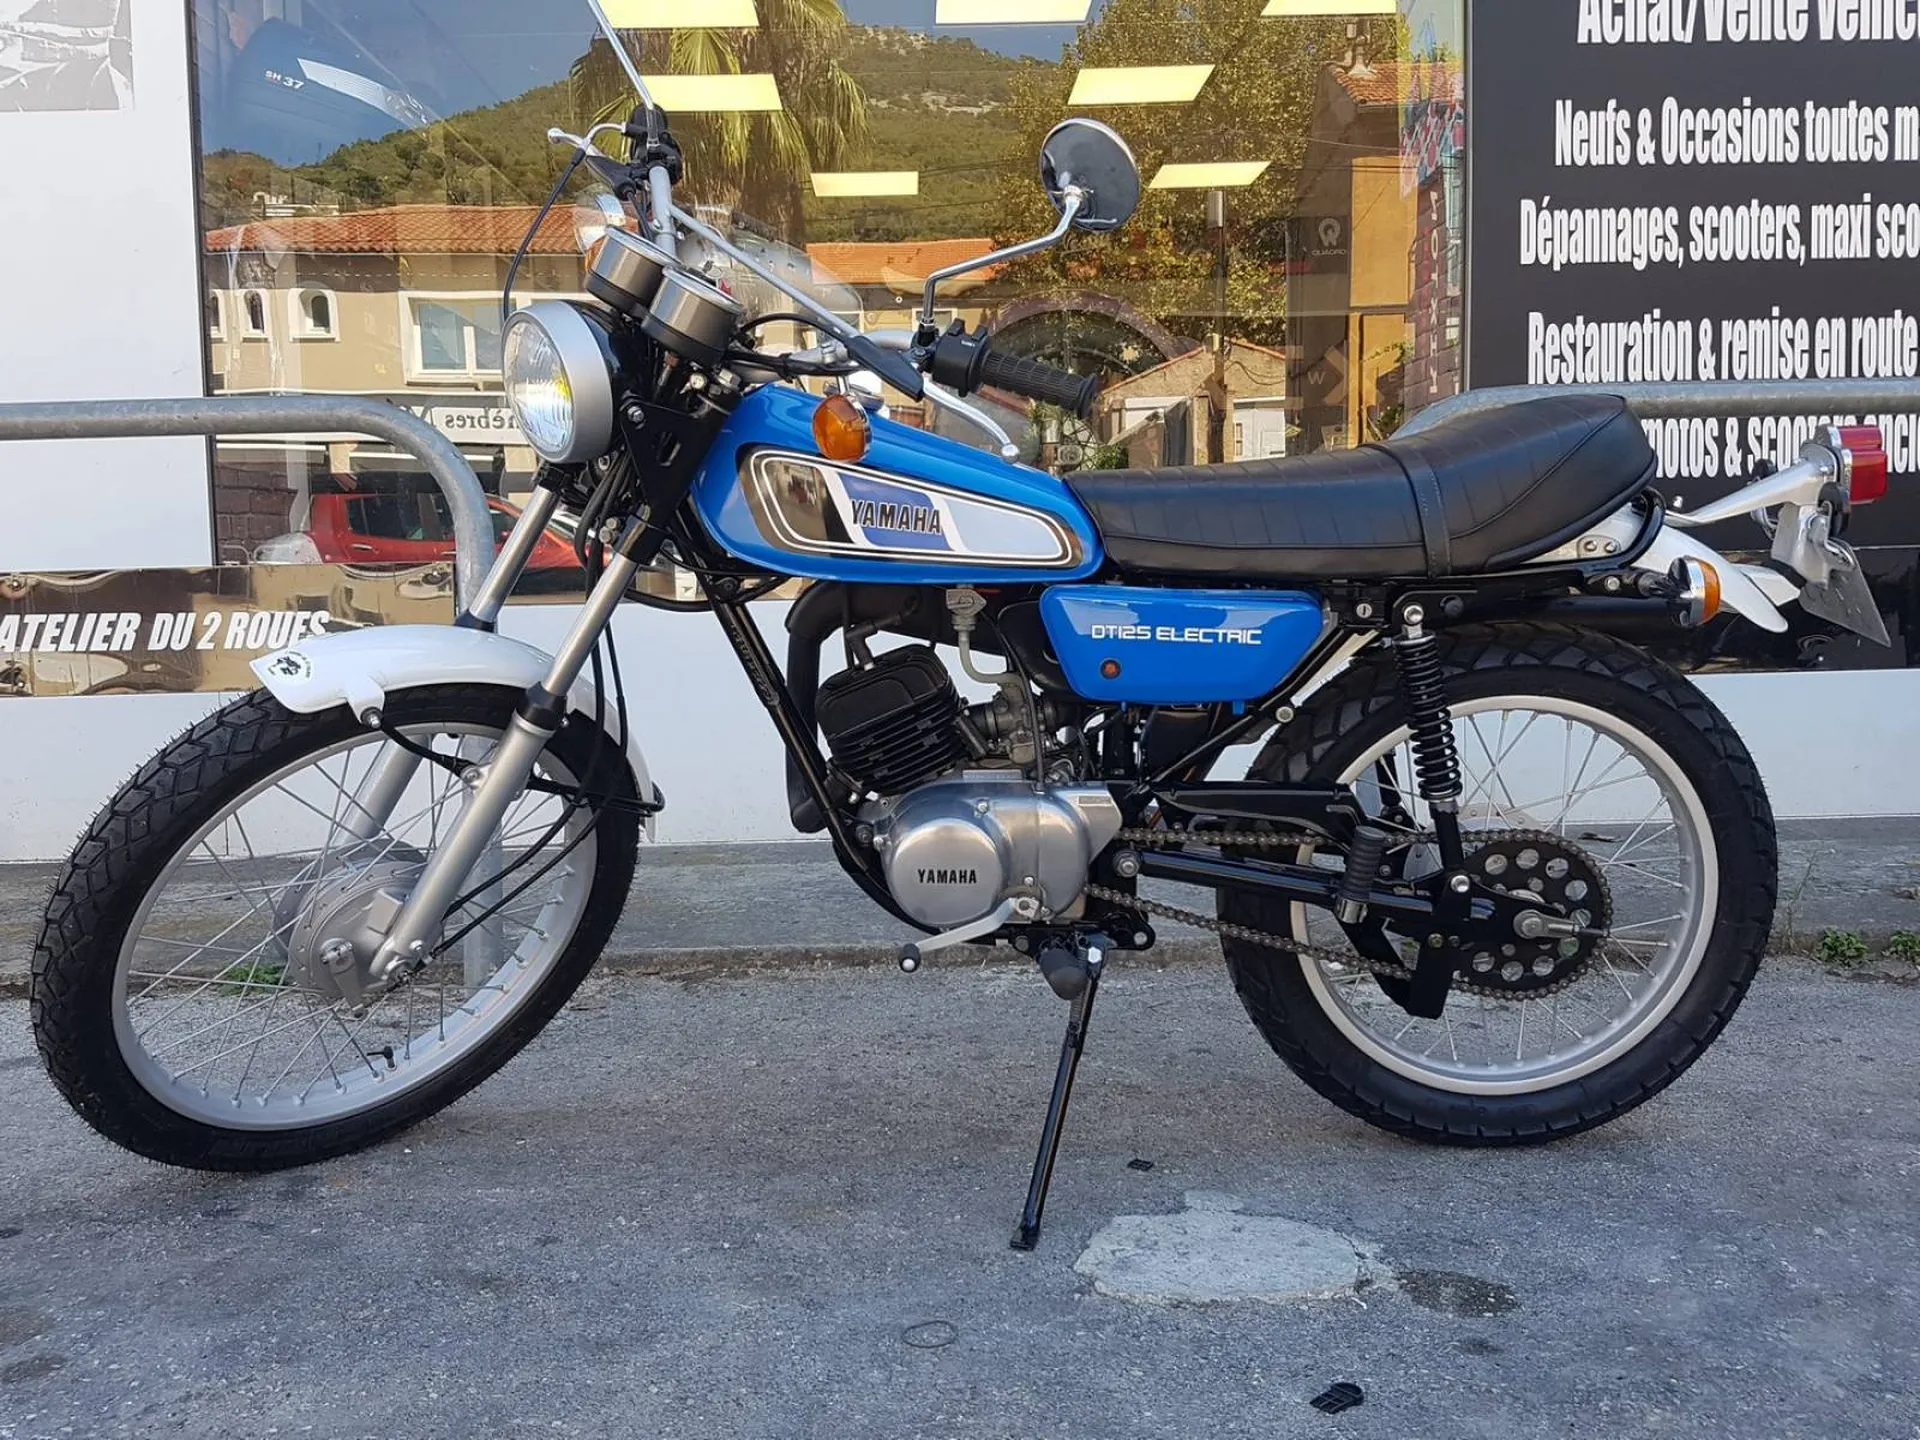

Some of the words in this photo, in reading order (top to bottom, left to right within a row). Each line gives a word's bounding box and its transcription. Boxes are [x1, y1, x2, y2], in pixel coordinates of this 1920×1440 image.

[282, 76, 305, 90] 37
[1555, 99, 1631, 166] Neufs
[1636, 107, 1656, 165] &
[1661, 96, 1800, 164] Occasions
[1804, 100, 1889, 162] toutes
[1520, 196, 1685, 272] Dépannages,
[1689, 199, 1806, 267] scooters,
[1811, 192, 1871, 259] maxi
[1876, 202, 1920, 259] sco
[1528, 308, 1692, 385] Restauration
[1699, 317, 1716, 381] &
[1721, 306, 1809, 380] remise
[1815, 318, 1847, 378] en
[1852, 309, 1919, 378] route
[1641, 416, 1719, 479] motos
[1725, 415, 1743, 477] &
[850, 499, 942, 535] YAMAHA
[0, 612, 142, 652] ATELIER
[147, 612, 197, 651] DU
[197, 611, 222, 650] 2
[1091, 624, 1151, 640] DT125
[1156, 626, 1262, 645] ELECTRIC
[918, 869, 977, 884] YAMAHA
